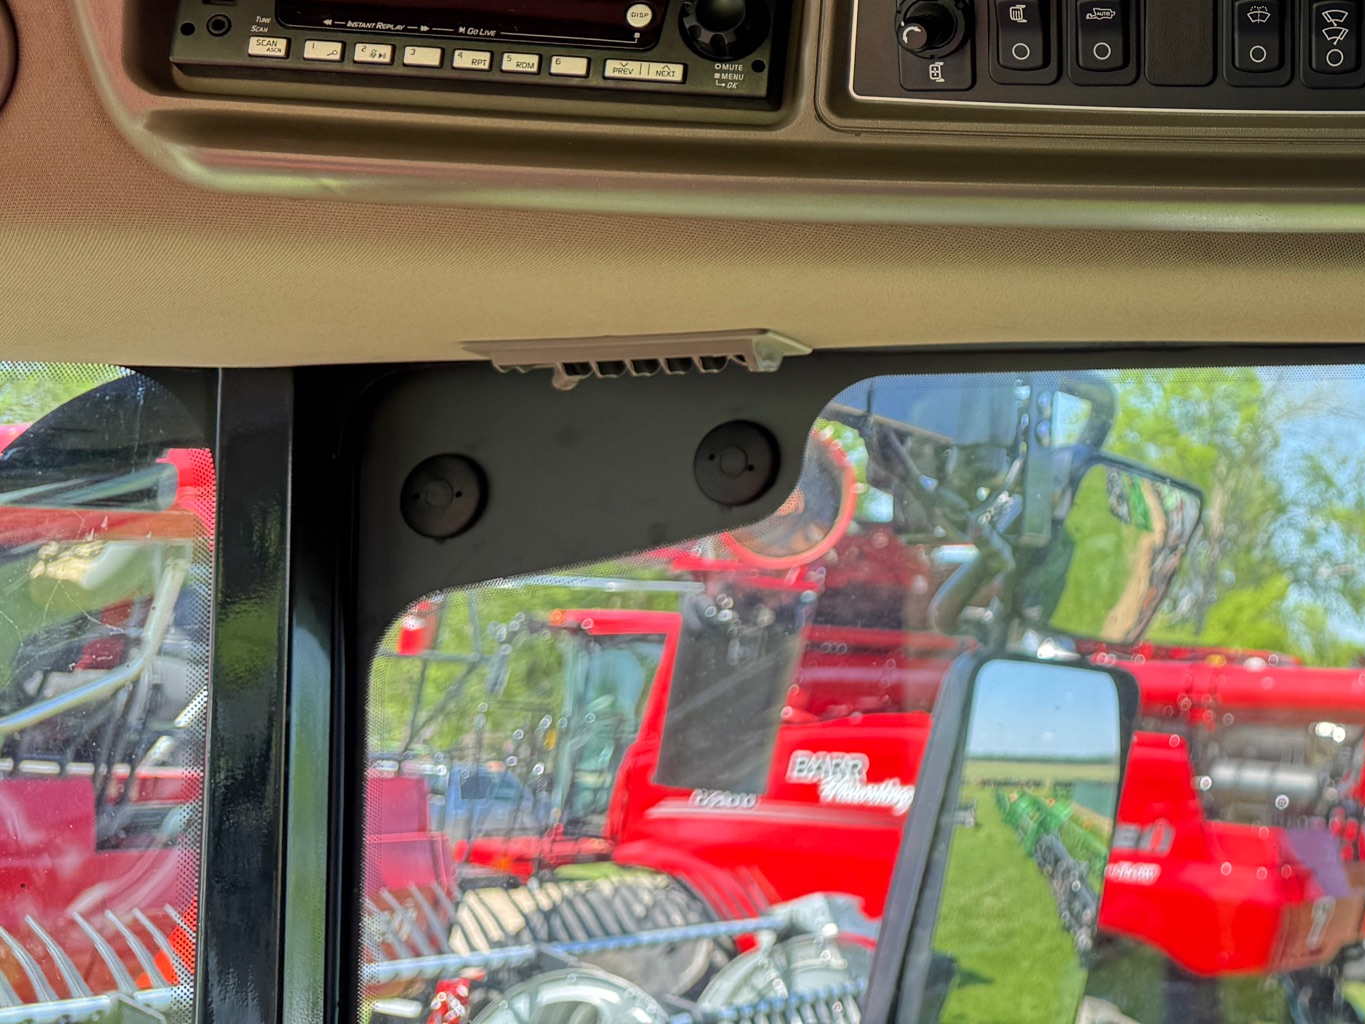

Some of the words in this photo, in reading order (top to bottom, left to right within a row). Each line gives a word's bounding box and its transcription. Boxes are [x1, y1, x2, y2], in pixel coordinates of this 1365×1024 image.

[471, 58, 487, 66] RPT
[516, 61, 535, 69] RDM
[722, 63, 744, 71] MUTE
